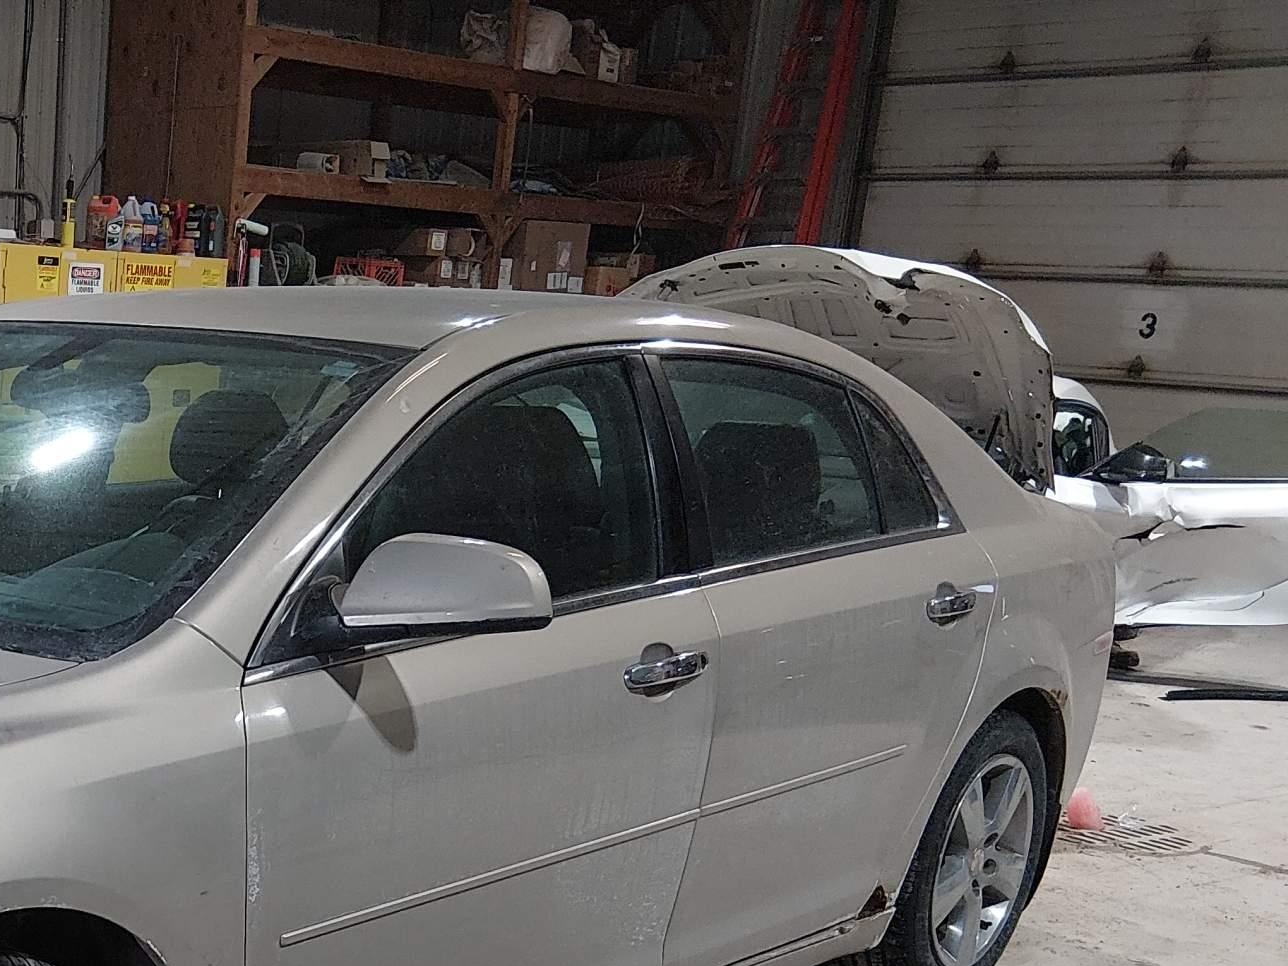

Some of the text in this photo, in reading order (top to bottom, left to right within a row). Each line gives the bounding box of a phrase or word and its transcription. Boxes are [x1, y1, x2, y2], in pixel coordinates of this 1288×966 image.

[74, 269, 99, 278] DANGER
[126, 263, 172, 277] FLAMMABLE
[72, 279, 99, 287] FLAMMABLE
[125, 276, 171, 287] KEEP FIRE AWAY
[1139, 312, 1158, 340] 3
